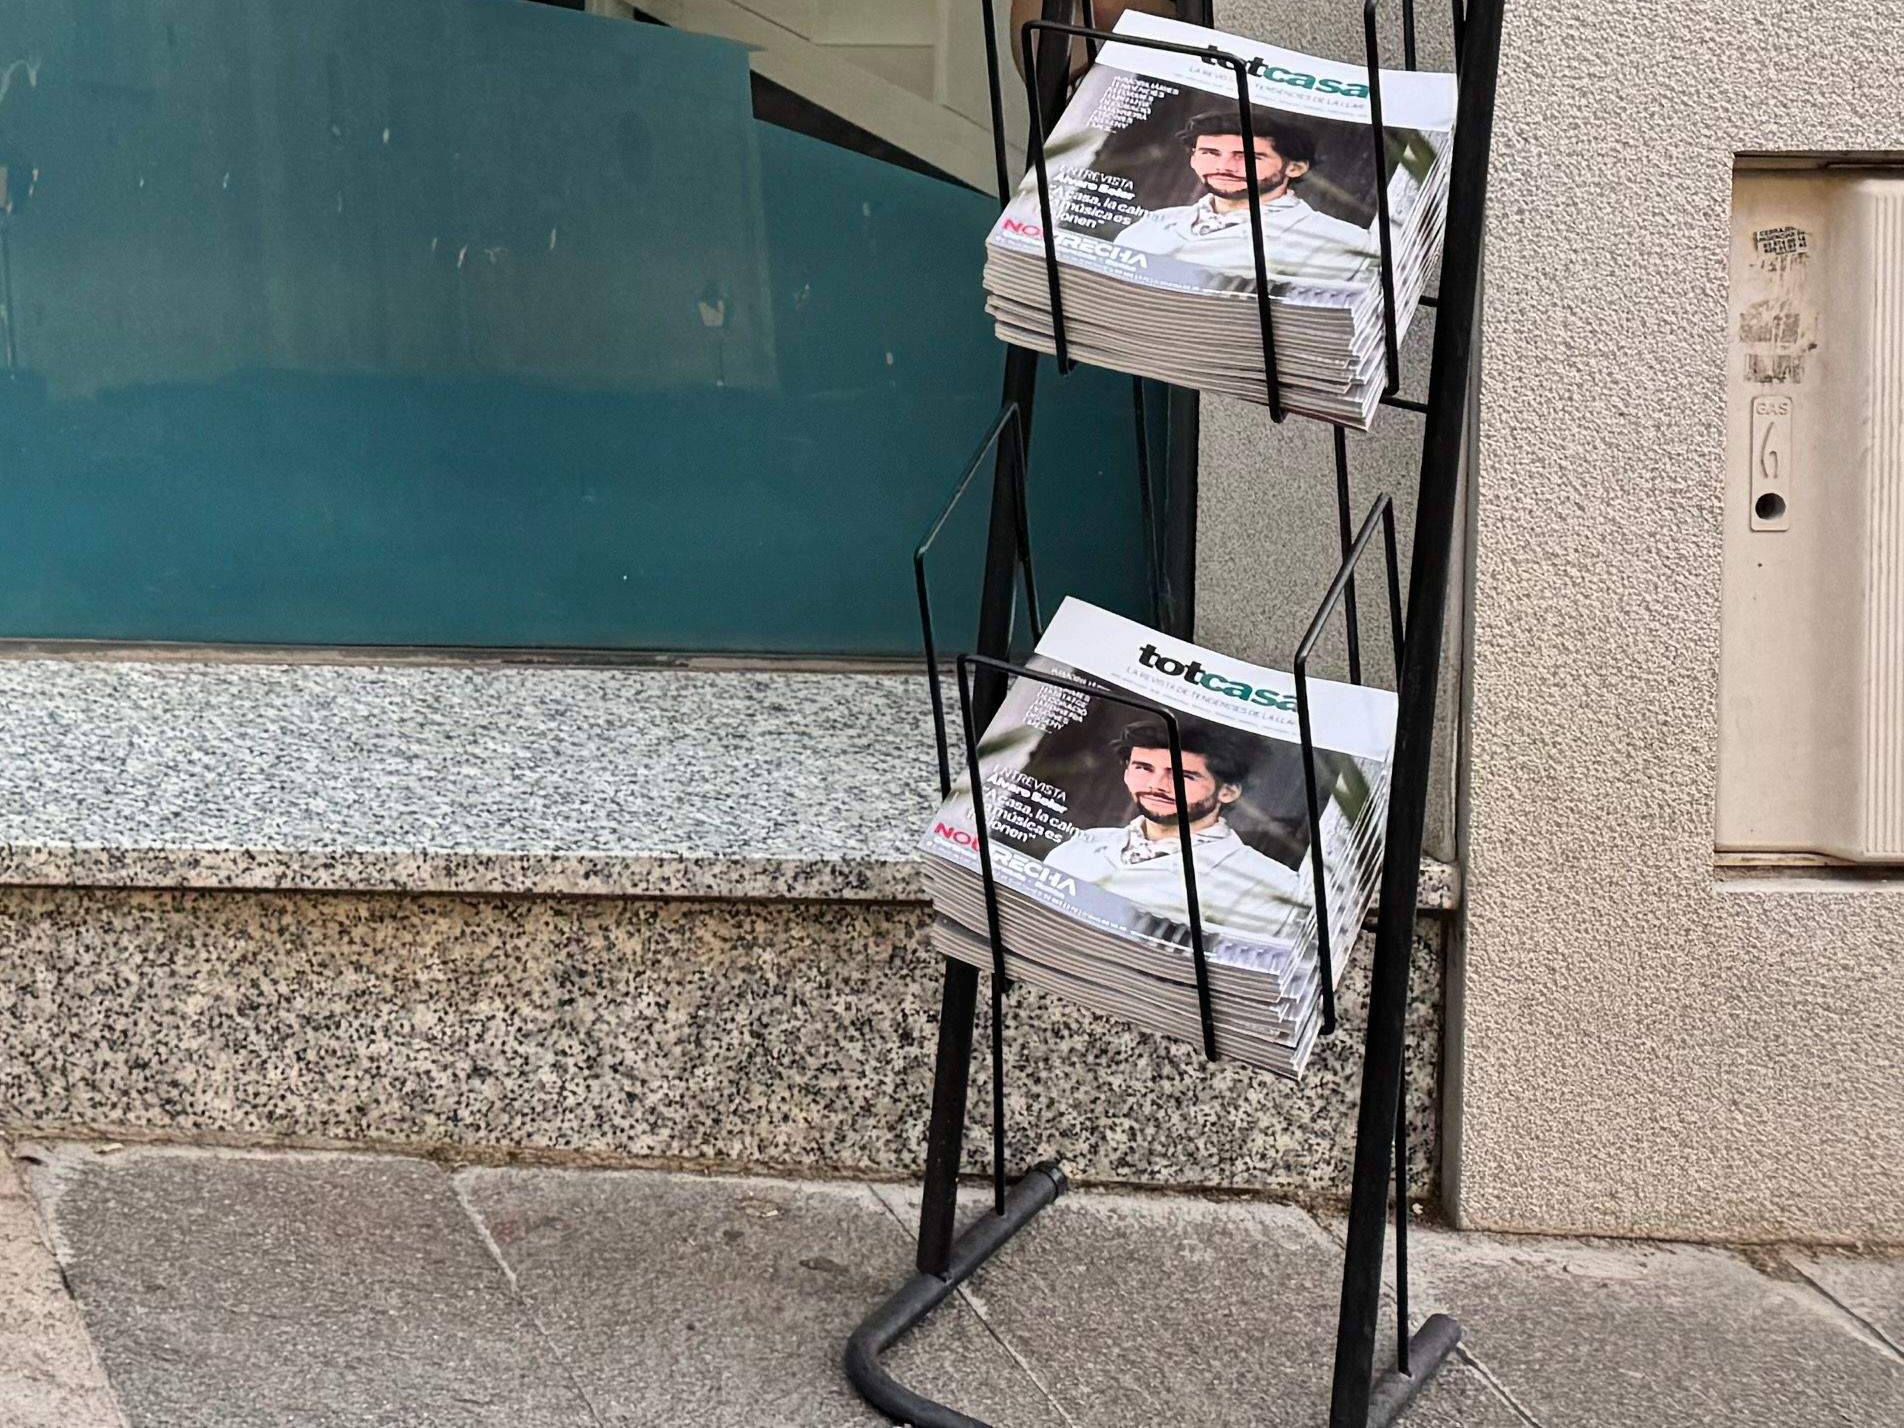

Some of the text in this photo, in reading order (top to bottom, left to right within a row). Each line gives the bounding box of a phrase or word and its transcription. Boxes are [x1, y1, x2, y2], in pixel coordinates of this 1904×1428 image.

[1001, 217, 1044, 240] NO
[1756, 403, 1788, 415] GAS
[993, 763, 1067, 802] ENTREVISTA
[1036, 808, 1049, 822] la
